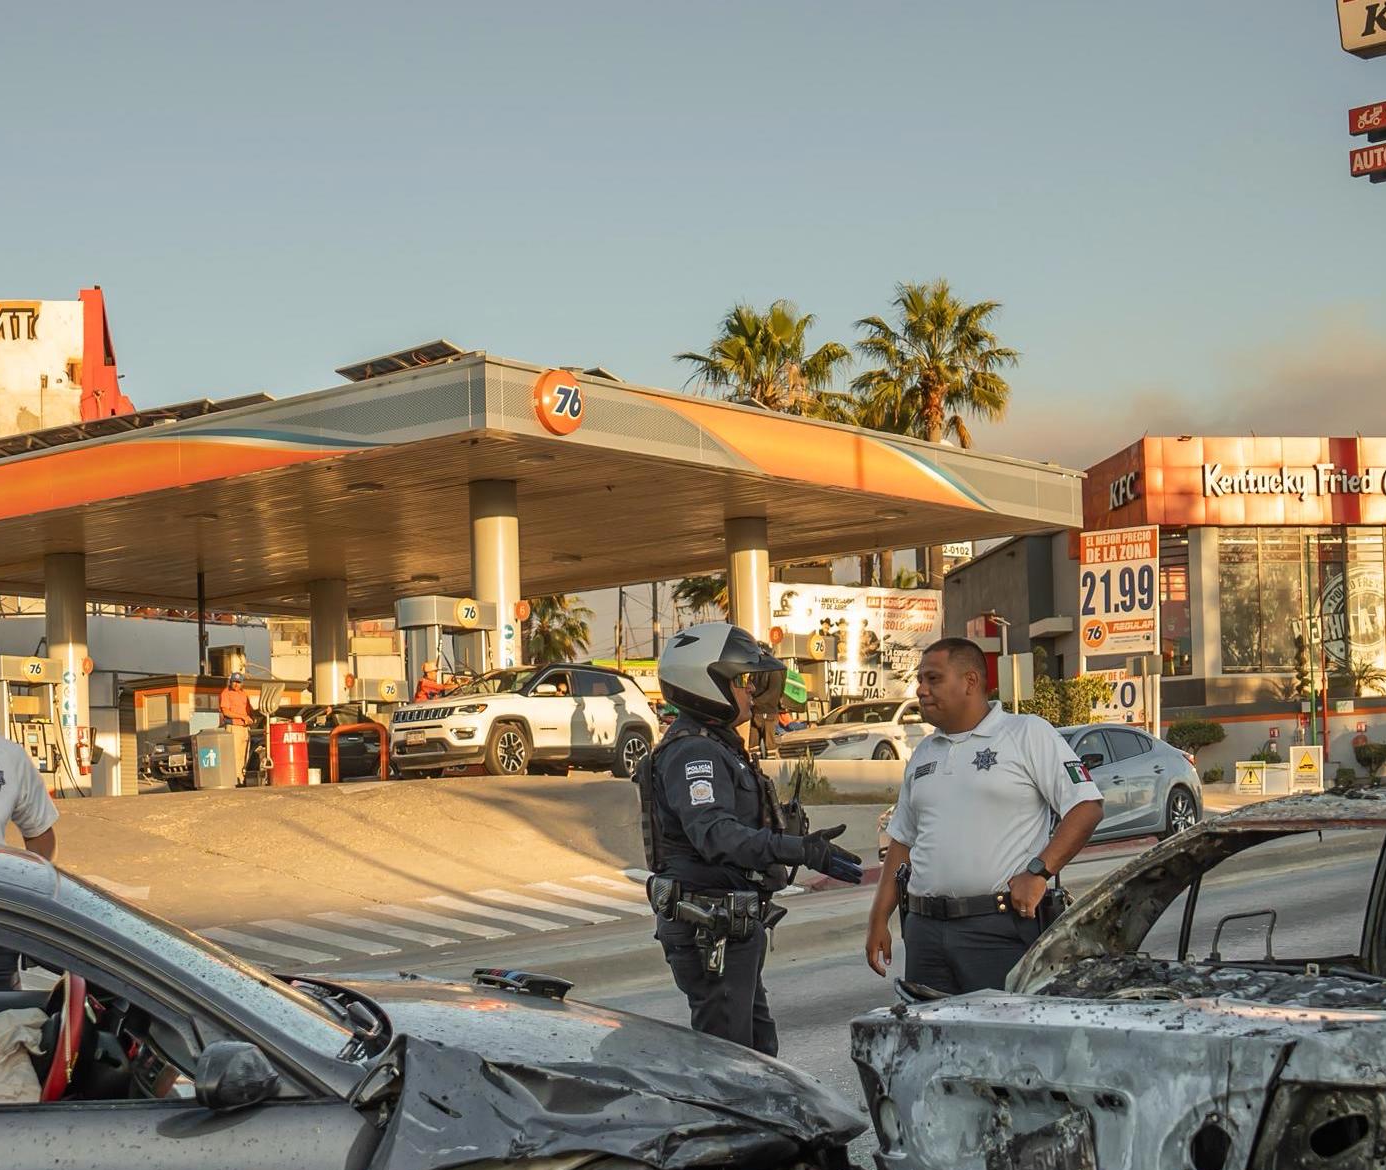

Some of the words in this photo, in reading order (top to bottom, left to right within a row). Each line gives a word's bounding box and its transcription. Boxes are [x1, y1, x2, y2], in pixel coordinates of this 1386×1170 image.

[553, 385, 582, 419] 76
[1202, 463, 1310, 501] Kentucky
[1313, 463, 1374, 498] Fried
[1109, 472, 1138, 511] KFC
[1086, 536, 1094, 546] EL
[1096, 533, 1121, 545] MEJOR
[1122, 530, 1152, 542] PRECIO
[1086, 547, 1101, 563] DE
[1103, 545, 1118, 561] LA
[1119, 542, 1151, 560] ZONA
[1081, 564, 1154, 616] 21.99
[463, 607, 476, 619] 76
[1087, 626, 1102, 640] 76
[814, 641, 825, 652] 76
[29, 664, 42, 674] 76
[386, 685, 396, 694] 76
